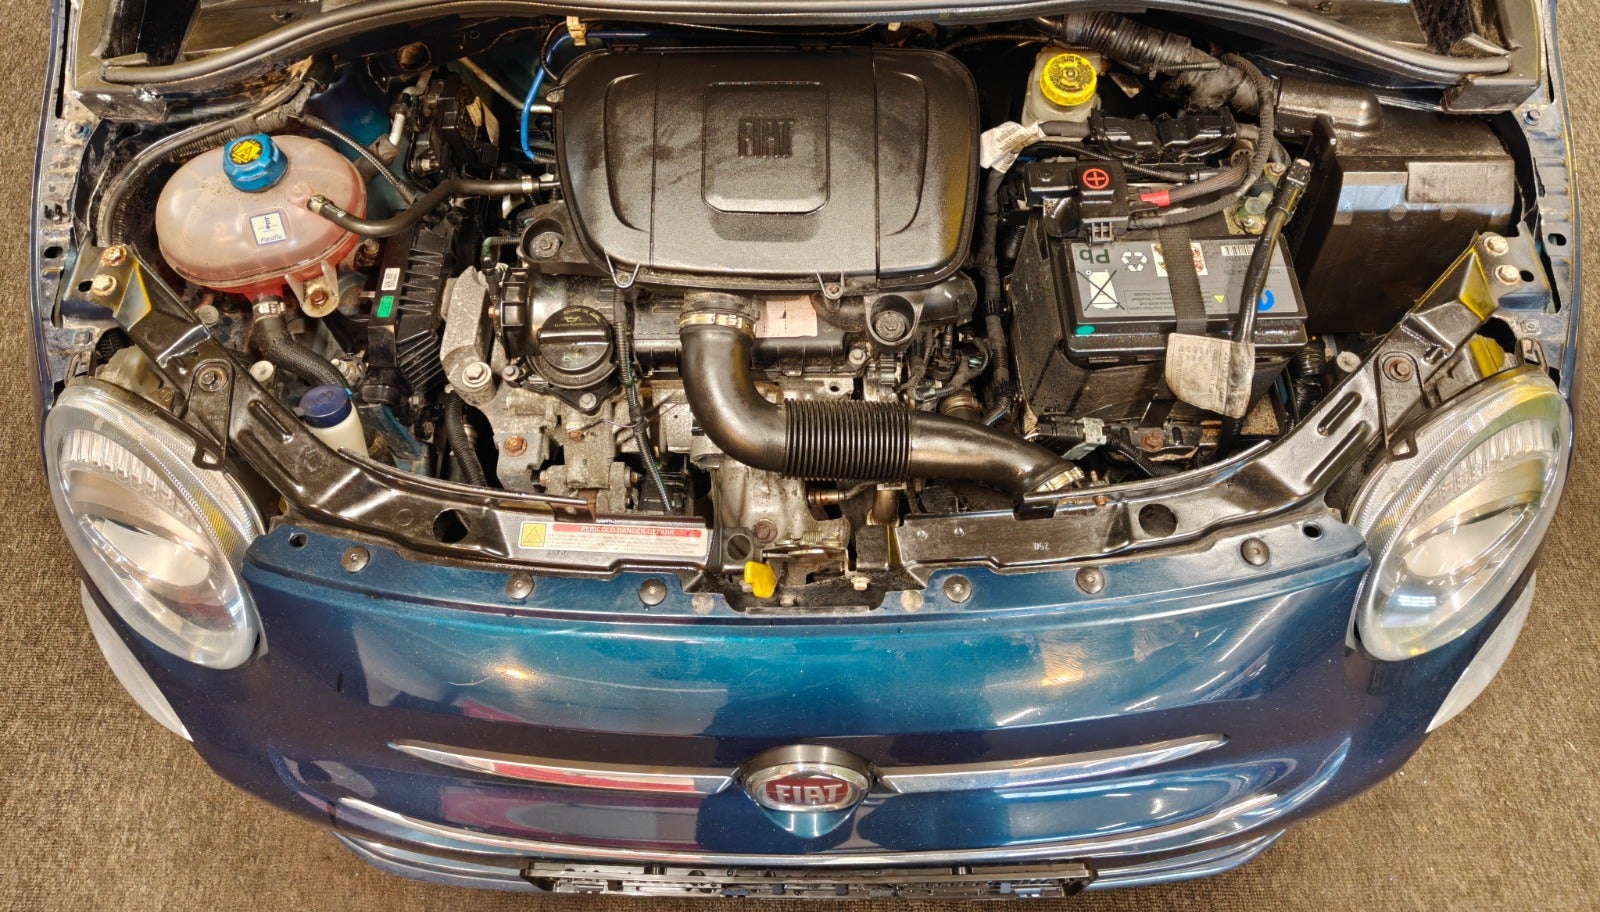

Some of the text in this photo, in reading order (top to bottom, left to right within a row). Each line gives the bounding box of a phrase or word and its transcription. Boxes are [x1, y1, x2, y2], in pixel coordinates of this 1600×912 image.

[738, 118, 793, 158] FIAT
[1079, 248, 1110, 264] Pb
[776, 784, 842, 804] FIAT
